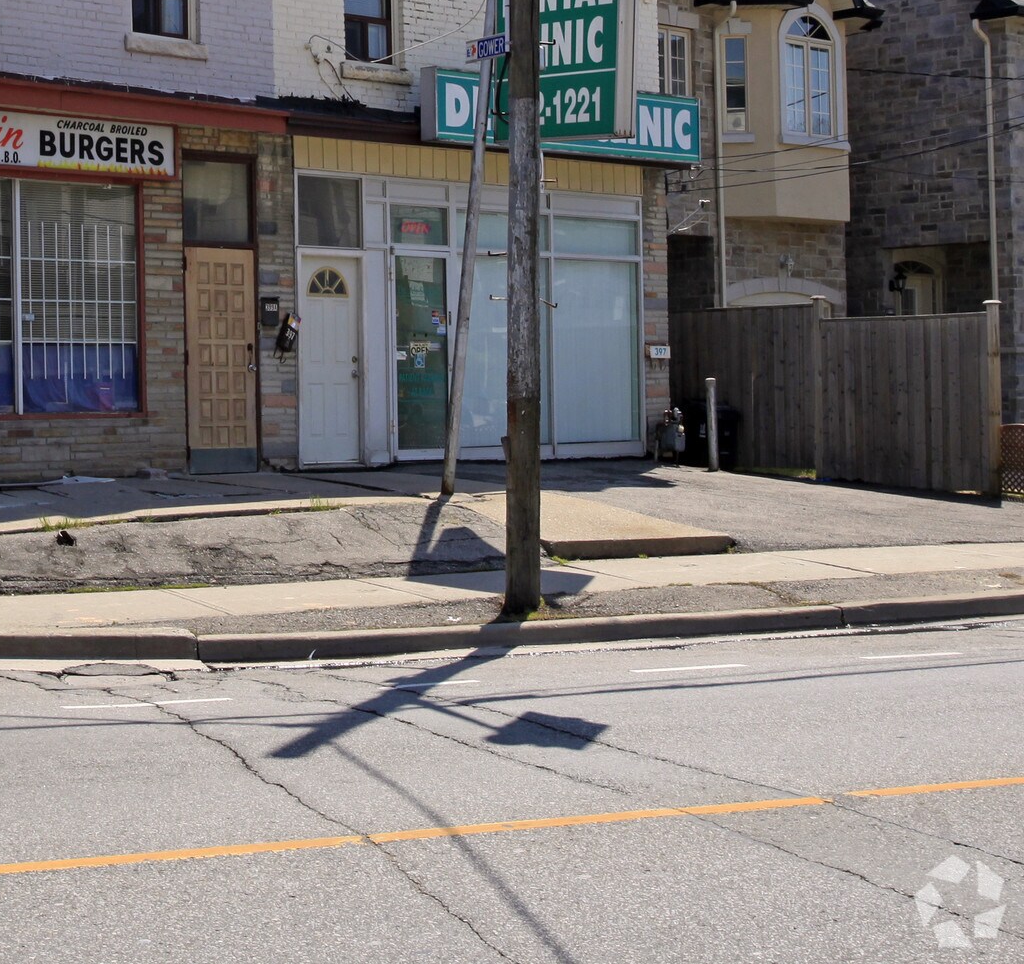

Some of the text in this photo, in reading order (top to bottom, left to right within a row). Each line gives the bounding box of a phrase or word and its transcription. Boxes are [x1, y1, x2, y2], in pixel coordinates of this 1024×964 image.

[478, 37, 504, 58] GOWER
[541, 16, 604, 67] INIC
[56, 120, 148, 136] CHARCOAL BROILED
[40, 129, 164, 166] BURGERS
[655, 347, 667, 356] 397
